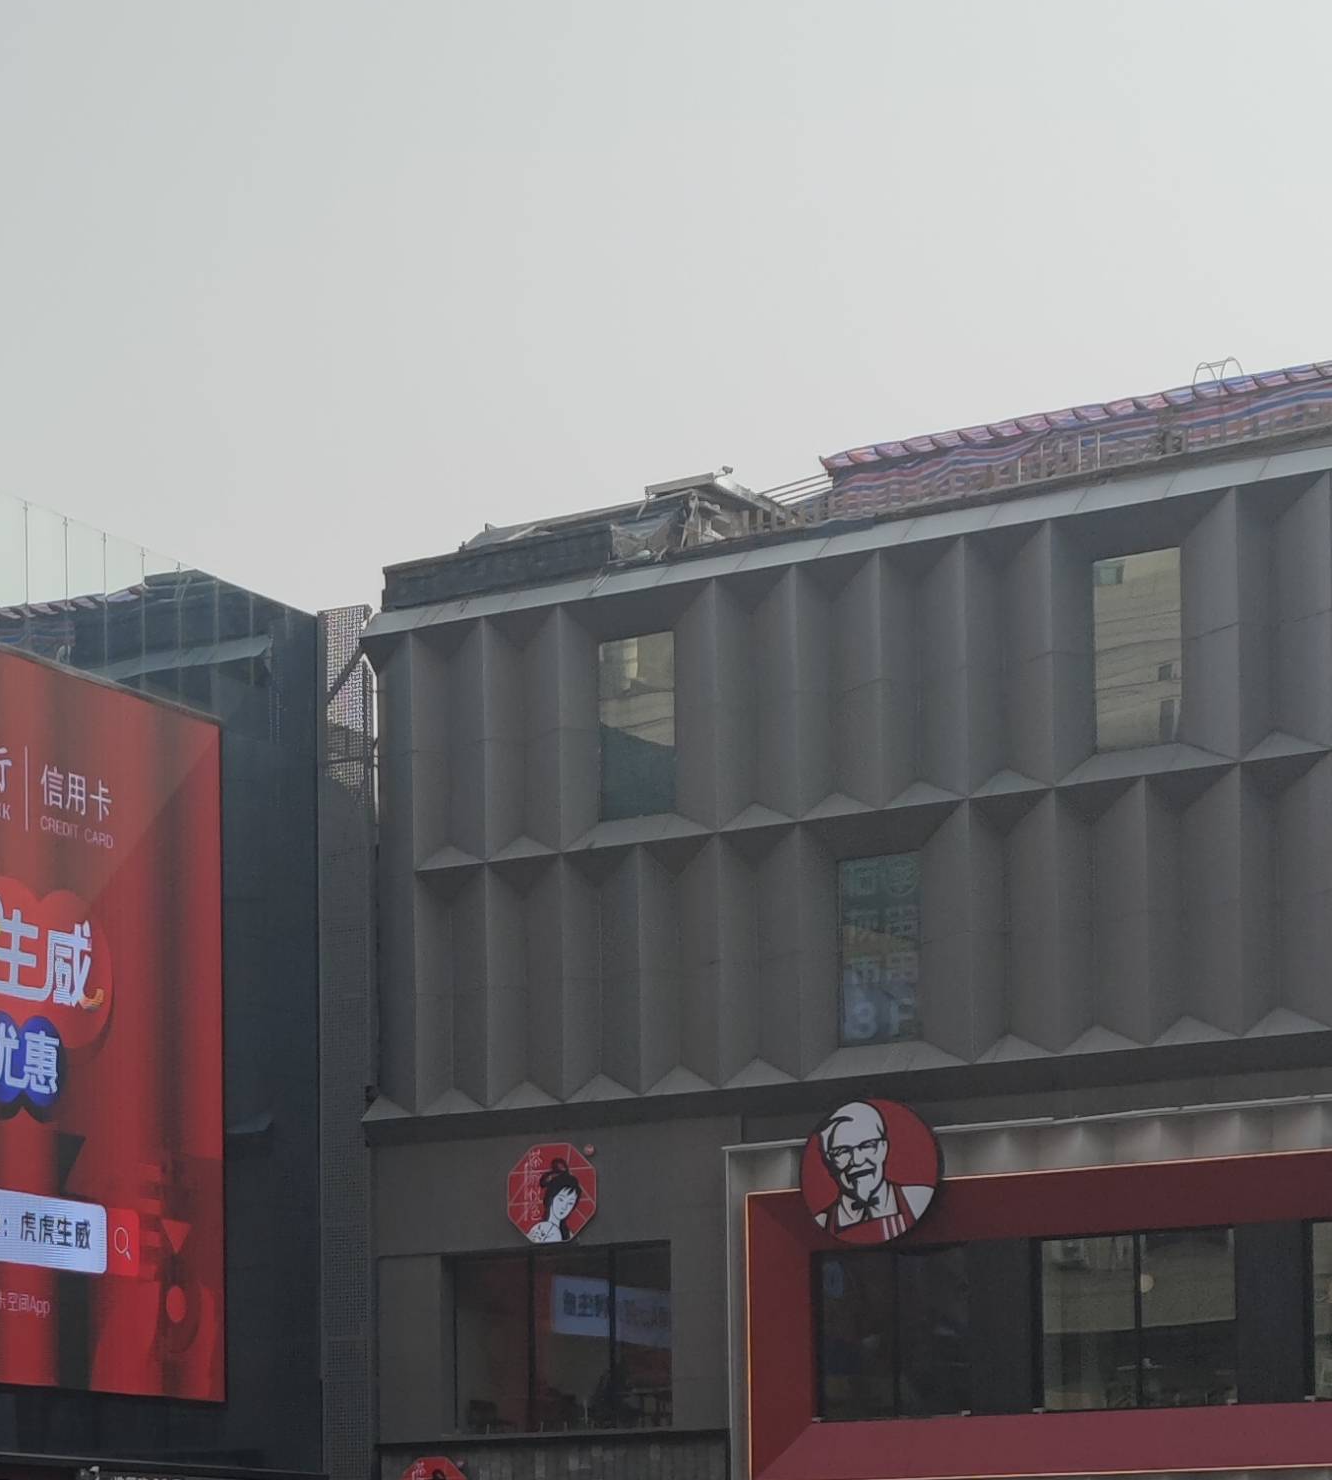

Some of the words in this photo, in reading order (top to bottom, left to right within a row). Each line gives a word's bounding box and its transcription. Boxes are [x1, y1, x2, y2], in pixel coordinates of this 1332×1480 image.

[40, 763, 112, 822] 信用卡
[40, 815, 80, 839] CREDIT
[84, 827, 114, 850] CARD
